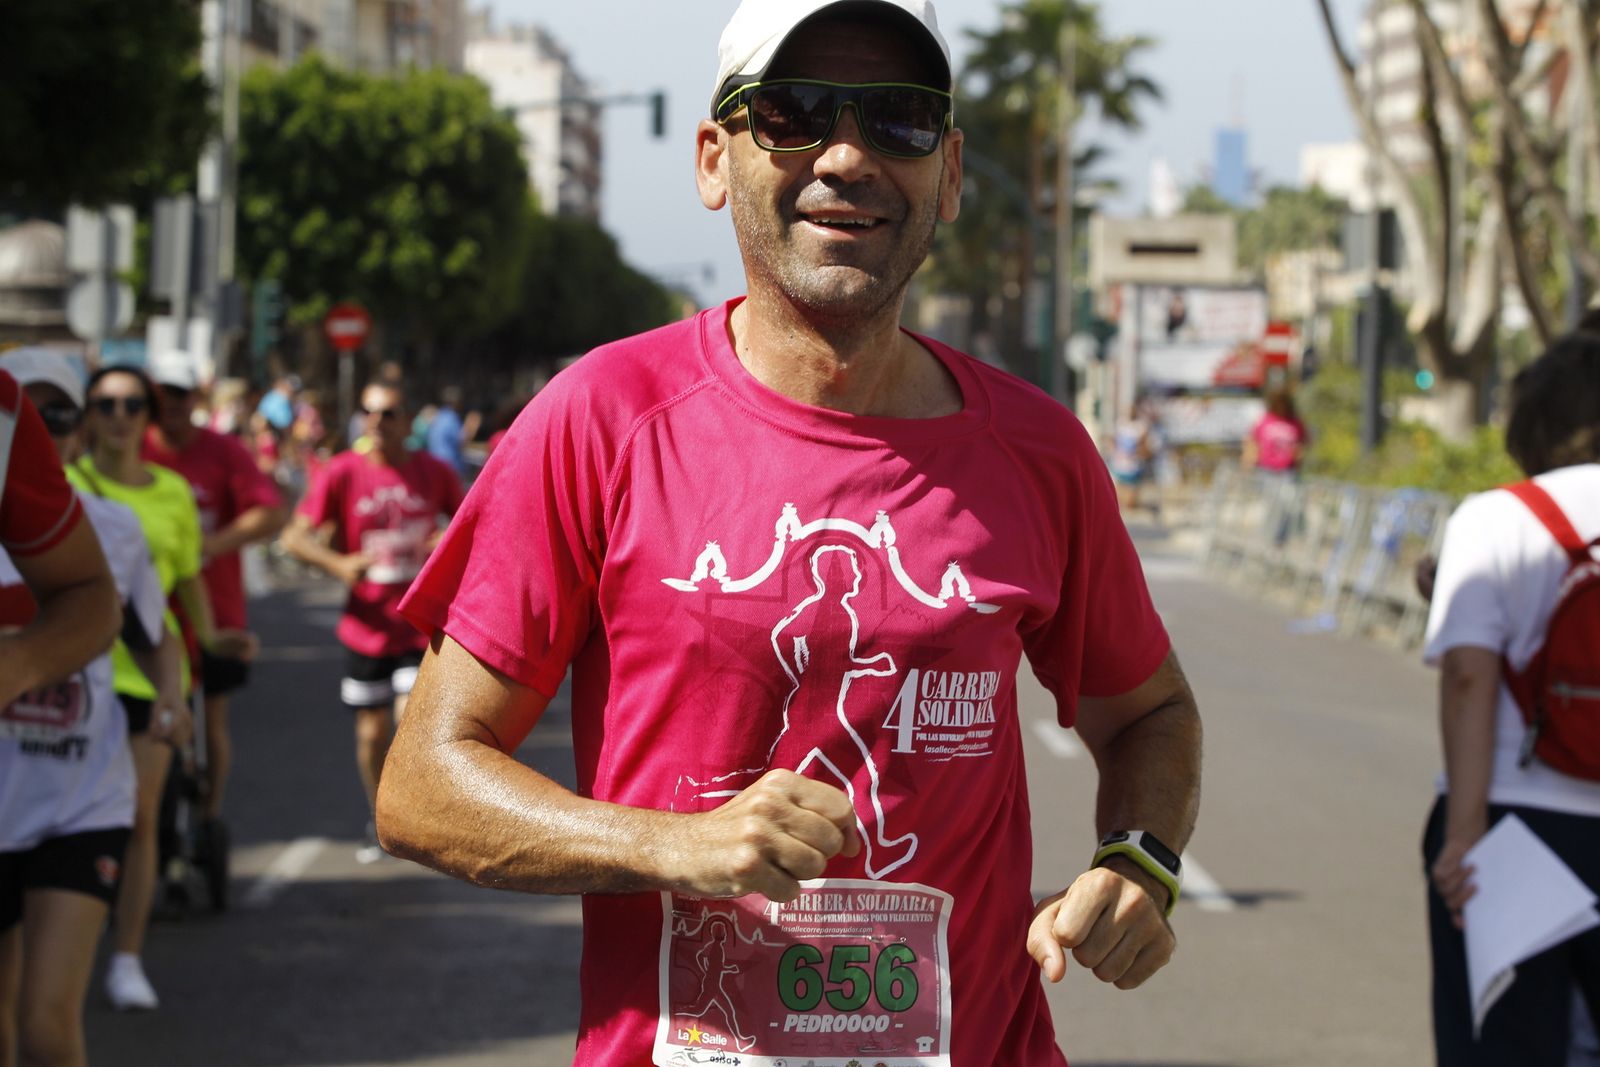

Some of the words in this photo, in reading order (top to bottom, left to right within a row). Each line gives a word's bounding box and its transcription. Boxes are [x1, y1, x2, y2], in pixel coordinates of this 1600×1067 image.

[921, 669, 1001, 699] CARRER
[881, 668, 921, 753] 4
[928, 733, 938, 741] LAS
[856, 893, 936, 912] SOLIDARIA
[781, 913, 797, 922] POR
[798, 913, 812, 922] LAS
[870, 913, 888, 922] POCO
[889, 913, 934, 923] FRECUENTES
[781, 925, 873, 934] lasallecorreparaayudar.com
[777, 943, 919, 1012] 656
[783, 1014, 890, 1033] PEDROOOO
[677, 1028, 690, 1041] La
[701, 1032, 728, 1046] Salle
[709, 1055, 732, 1064] asisa
